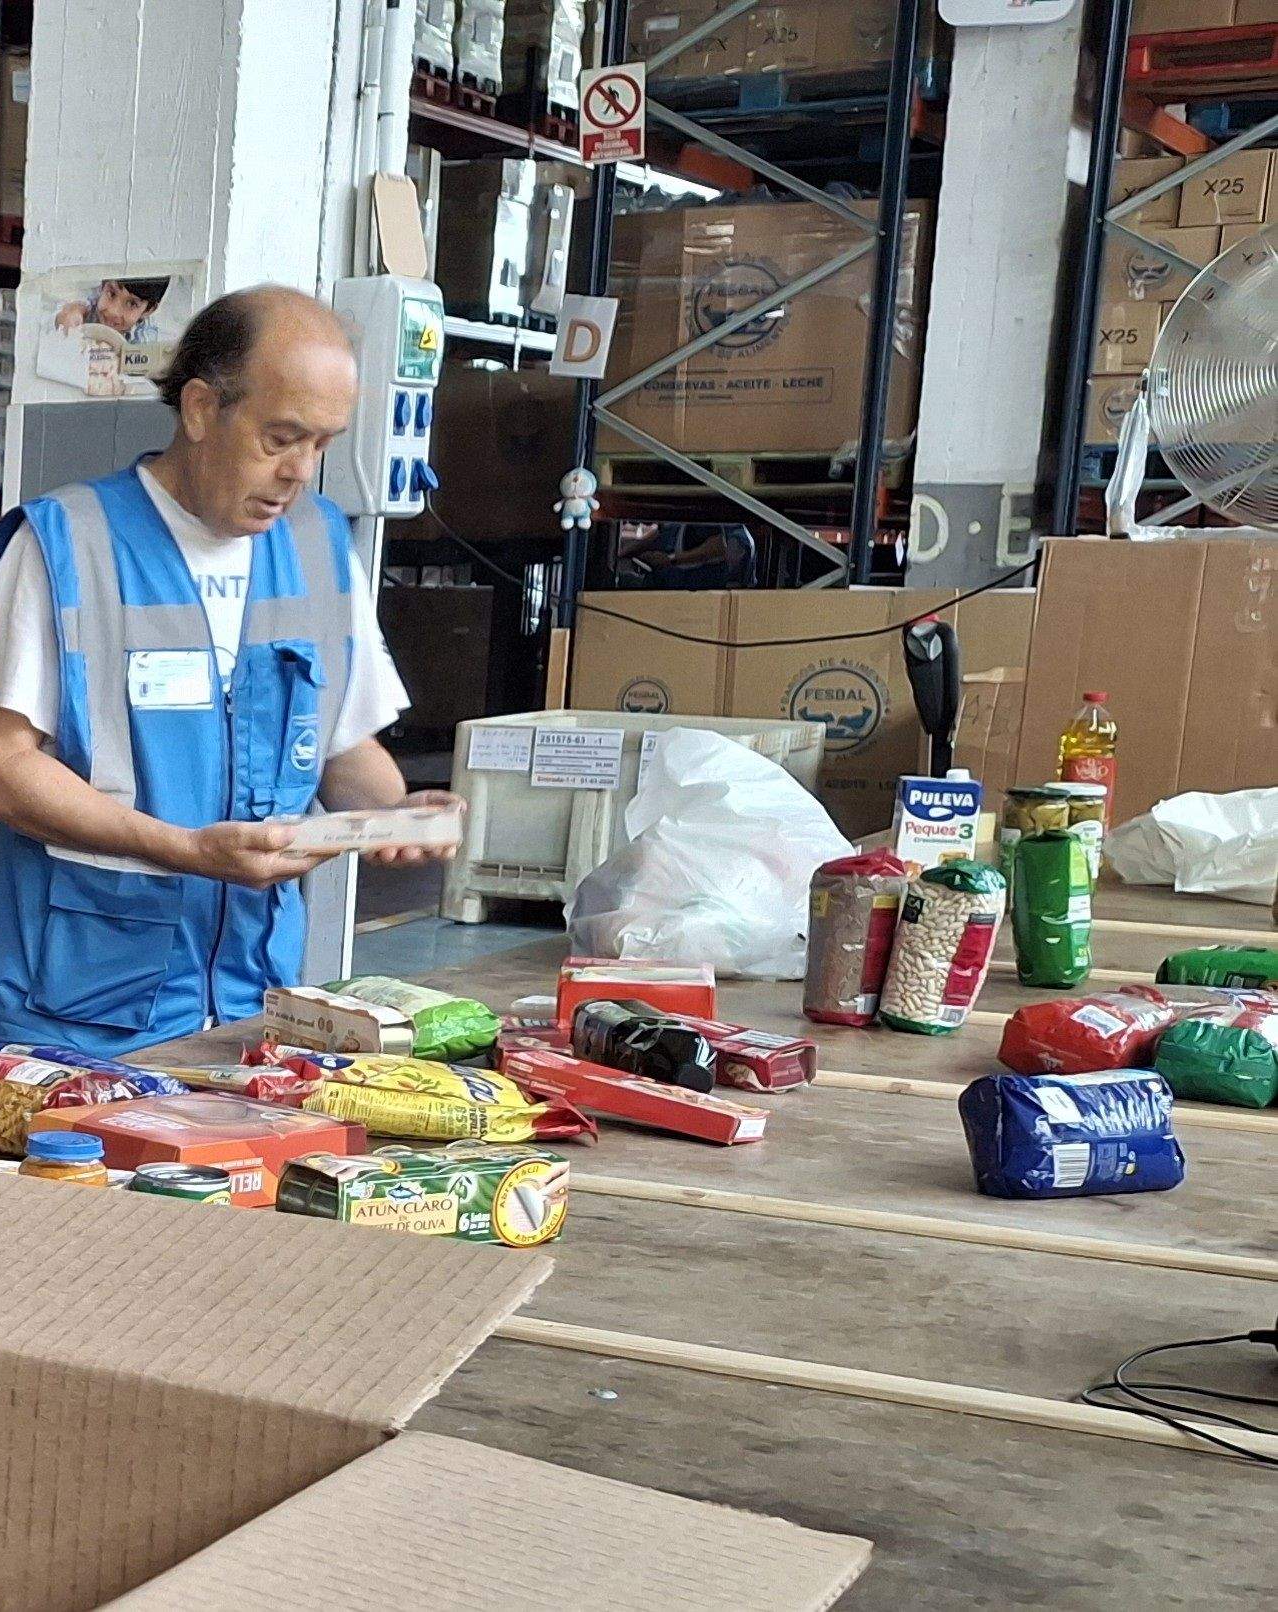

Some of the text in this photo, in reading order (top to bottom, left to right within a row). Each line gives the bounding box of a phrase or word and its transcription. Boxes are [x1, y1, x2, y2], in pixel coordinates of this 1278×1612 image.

[1202, 178, 1244, 197] X25
[563, 319, 602, 362] D
[1099, 328, 1138, 346] X25
[124, 354, 149, 366] Kilo
[782, 376, 824, 389] LECHE
[909, 789, 974, 808] PULEVA
[905, 821, 974, 839] Peques 3
[403, 1199, 453, 1214] CLARO
[413, 1218, 447, 1231] OLIVA
[459, 1212, 470, 1232] 6
